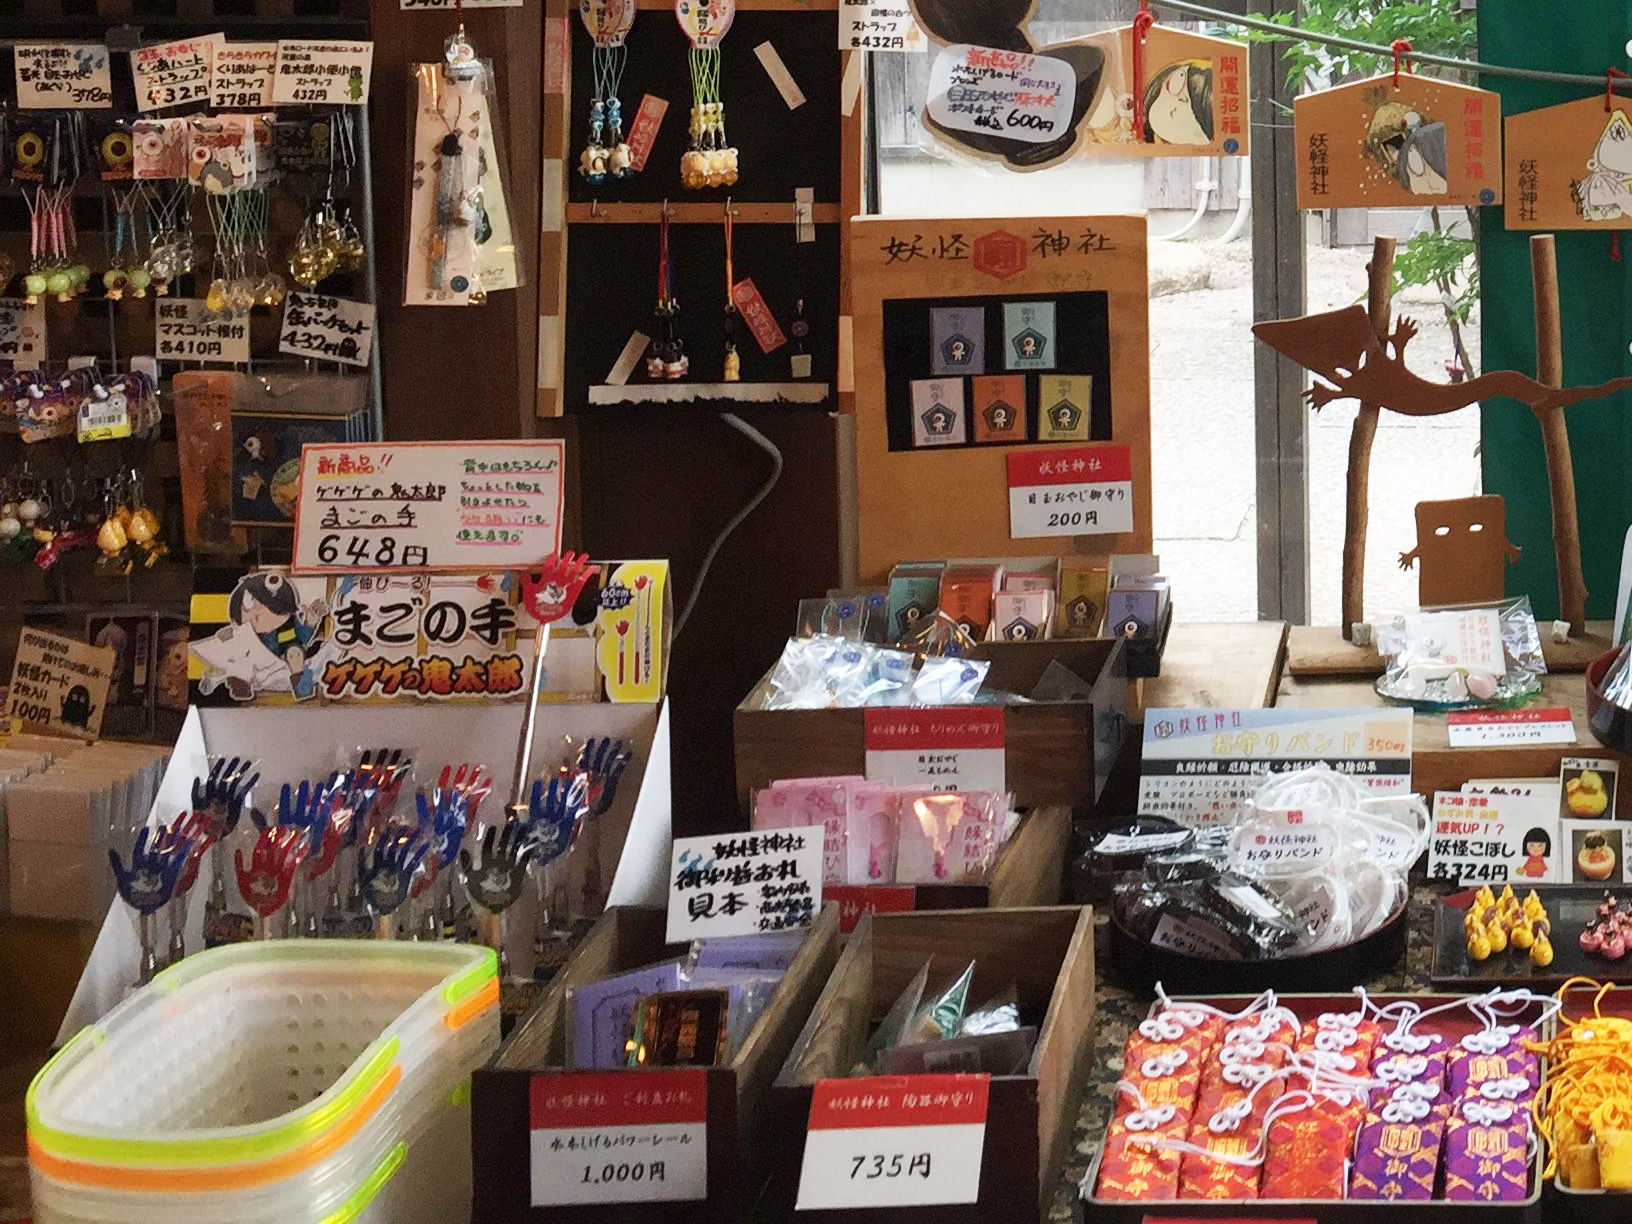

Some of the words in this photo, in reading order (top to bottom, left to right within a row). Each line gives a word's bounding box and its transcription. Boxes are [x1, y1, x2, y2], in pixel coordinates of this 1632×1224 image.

[852, 21, 898, 32] ストラップ
[851, 36, 903, 49] 各432円
[216, 78, 265, 89] ストラップ
[292, 89, 327, 101] 432円
[1219, 56, 1241, 135] 開運招福
[216, 93, 261, 106] 378円
[1006, 109, 1055, 133] 600円
[1463, 97, 1485, 180] 開運招福
[1309, 131, 1330, 196] 妖怪神社
[1518, 158, 1539, 222] 妖怪神社
[881, 233, 970, 265] 妖怪
[1031, 227, 1117, 258] 神社
[159, 304, 188, 320] 妖怪
[160, 341, 222, 355] 各410円
[1039, 457, 1102, 475] 妖怪神社
[316, 481, 447, 499] ゲゲゲの鬼太郎
[1028, 487, 1125, 505] 目玉おやじ御守り
[320, 503, 417, 527] まごの手
[1047, 510, 1099, 528] 200円
[317, 534, 429, 566] 648円
[334, 598, 516, 646] まごの手
[17, 661, 71, 688] 妖怪カード
[324, 656, 523, 695] ゲゲゲの鬼太郎
[10, 699, 51, 725] 100円
[1211, 731, 1361, 755] お守りバンド
[712, 832, 807, 860] 妖怪神社
[1434, 839, 1516, 858] 妖怪こぼし
[1433, 861, 1508, 881] 各324円
[687, 892, 749, 923] 見本
[828, 1095, 890, 1111] 妖怪神社
[901, 1093, 975, 1110] 陶器御守り
[849, 1153, 932, 1180] 735円
